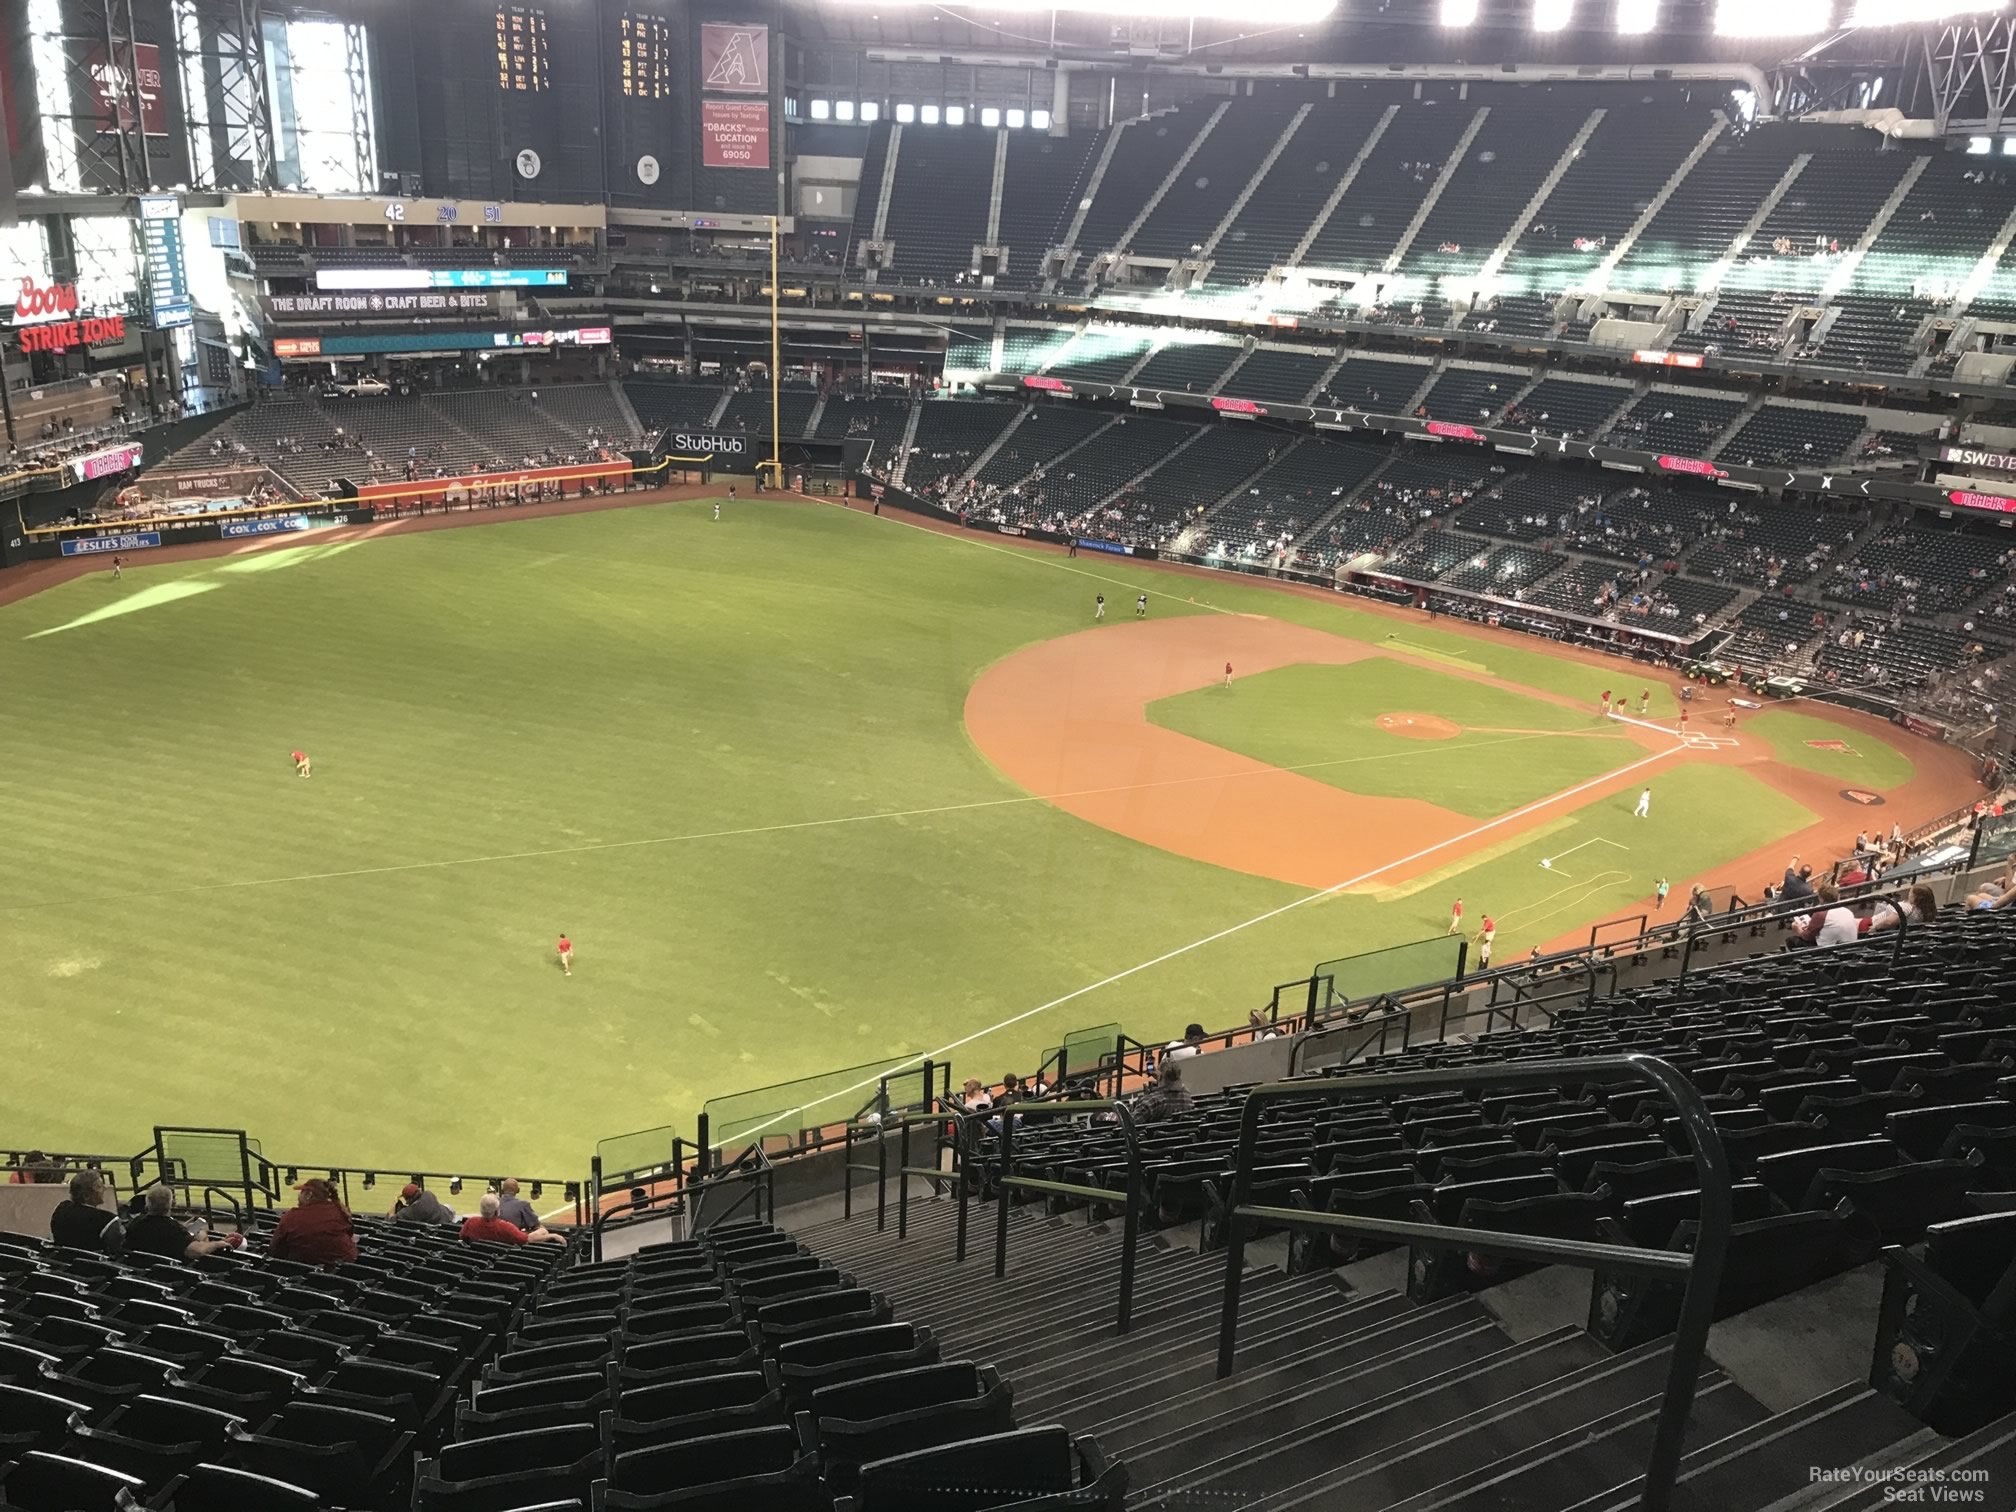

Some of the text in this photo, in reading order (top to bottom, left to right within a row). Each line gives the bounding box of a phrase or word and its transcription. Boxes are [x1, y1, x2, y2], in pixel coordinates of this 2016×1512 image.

[705, 103, 724, 111] Report
[740, 112, 760, 120] Texting
[704, 123, 746, 132] "DBACKS"
[715, 133, 757, 143] LOCATION
[723, 150, 750, 159] 69050
[384, 203, 405, 220] 42
[438, 206, 457, 222] 20
[484, 206, 502, 222] 51
[16, 275, 79, 317] Coors
[271, 295, 488, 311] THE DRAFT ROOM CRAFT BEER & BITES
[19, 321, 80, 353] STRIKE
[81, 316, 125, 343] ZONE
[675, 434, 742, 452] StubHub
[178, 478, 218, 490] RAM TRUCKS
[334, 515, 348, 524] 376
[229, 525, 250, 534] COX
[257, 521, 277, 531] COX
[10, 538, 21, 548] 413
[76, 537, 119, 552] LESLIE'S
